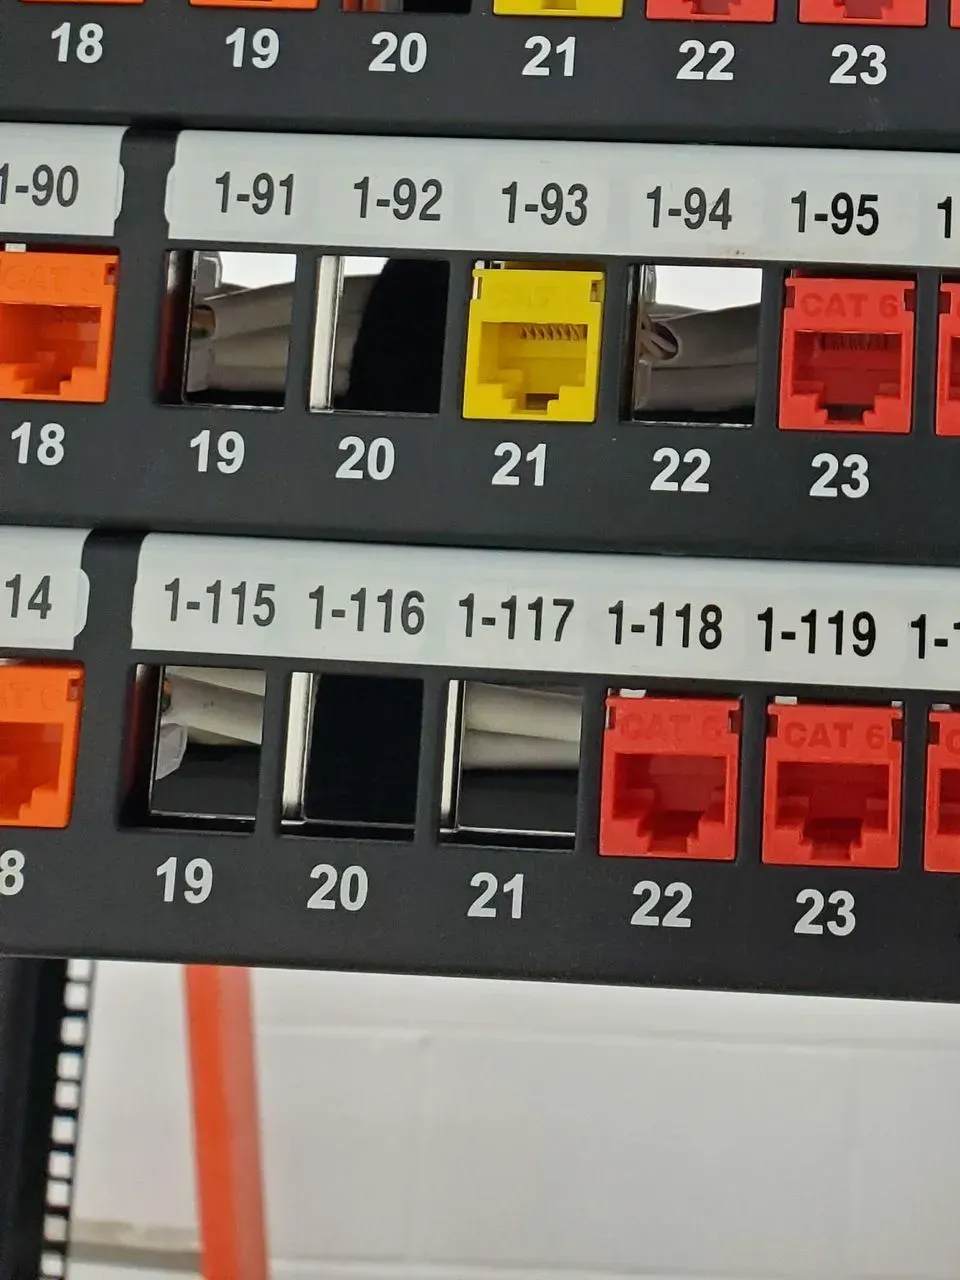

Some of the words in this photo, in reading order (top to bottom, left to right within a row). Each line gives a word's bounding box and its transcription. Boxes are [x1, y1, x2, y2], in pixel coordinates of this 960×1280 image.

[51, 22, 104, 64] 18
[225, 27, 280, 69] 19
[368, 31, 427, 73] 20
[521, 35, 576, 77] 21
[675, 39, 735, 81] 22
[829, 43, 887, 85] 23
[215, 171, 294, 216] 1-91
[353, 176, 443, 222] 1-92
[501, 181, 588, 227] 1-93
[646, 185, 733, 231] 1-94
[791, 190, 879, 237] 1-95
[800, 292, 868, 319] CAT
[879, 295, 899, 319] 6
[11, 421, 65, 466] 18
[190, 429, 245, 474] 19
[335, 435, 395, 481] 20
[491, 441, 547, 487] 21
[649, 447, 711, 493] 22
[809, 452, 870, 499] 23
[164, 577, 276, 627] 1-115
[308, 585, 425, 636] 1-116
[458, 592, 575, 642] 1-117
[608, 600, 723, 650] 1-118
[757, 606, 877, 658] 1-119
[617, 710, 690, 742] CAT
[785, 721, 853, 748] CAT
[866, 724, 885, 750] 6
[156, 856, 213, 904] 19
[306, 863, 369, 911] 20
[467, 871, 524, 919] 21
[630, 880, 693, 928] 22
[793, 888, 856, 937] 23
